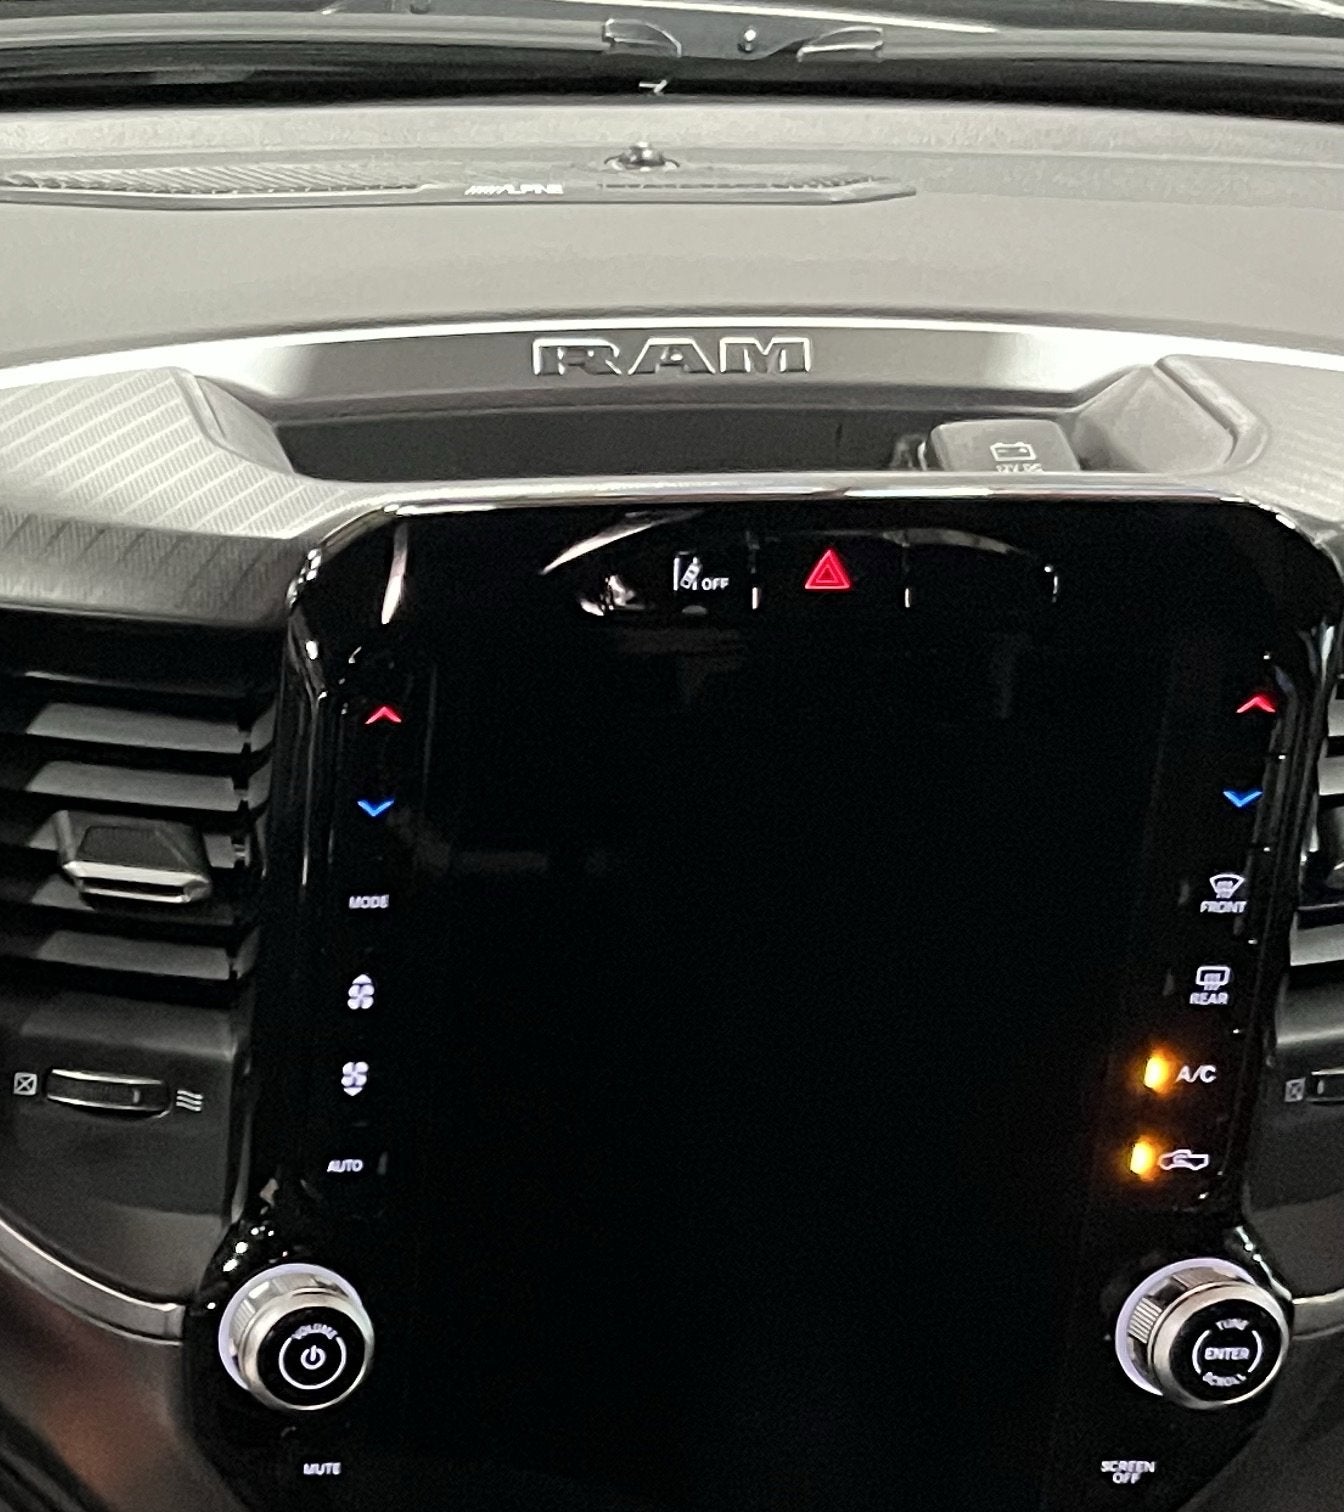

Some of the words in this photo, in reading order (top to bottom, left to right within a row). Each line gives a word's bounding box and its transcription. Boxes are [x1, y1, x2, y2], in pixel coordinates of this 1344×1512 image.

[533, 337, 812, 377] RAM
[701, 577, 729, 591] OFF
[349, 894, 389, 909] MODE
[1200, 901, 1247, 913] FRONT
[1189, 993, 1228, 1005] REAR
[1176, 1064, 1217, 1083] A/C
[327, 1158, 363, 1173] AUTO
[1205, 1347, 1250, 1361] ENTER
[303, 1462, 341, 1476] MUTE
[1100, 1460, 1156, 1473] SCREEN
[1112, 1472, 1142, 1484] OFF
